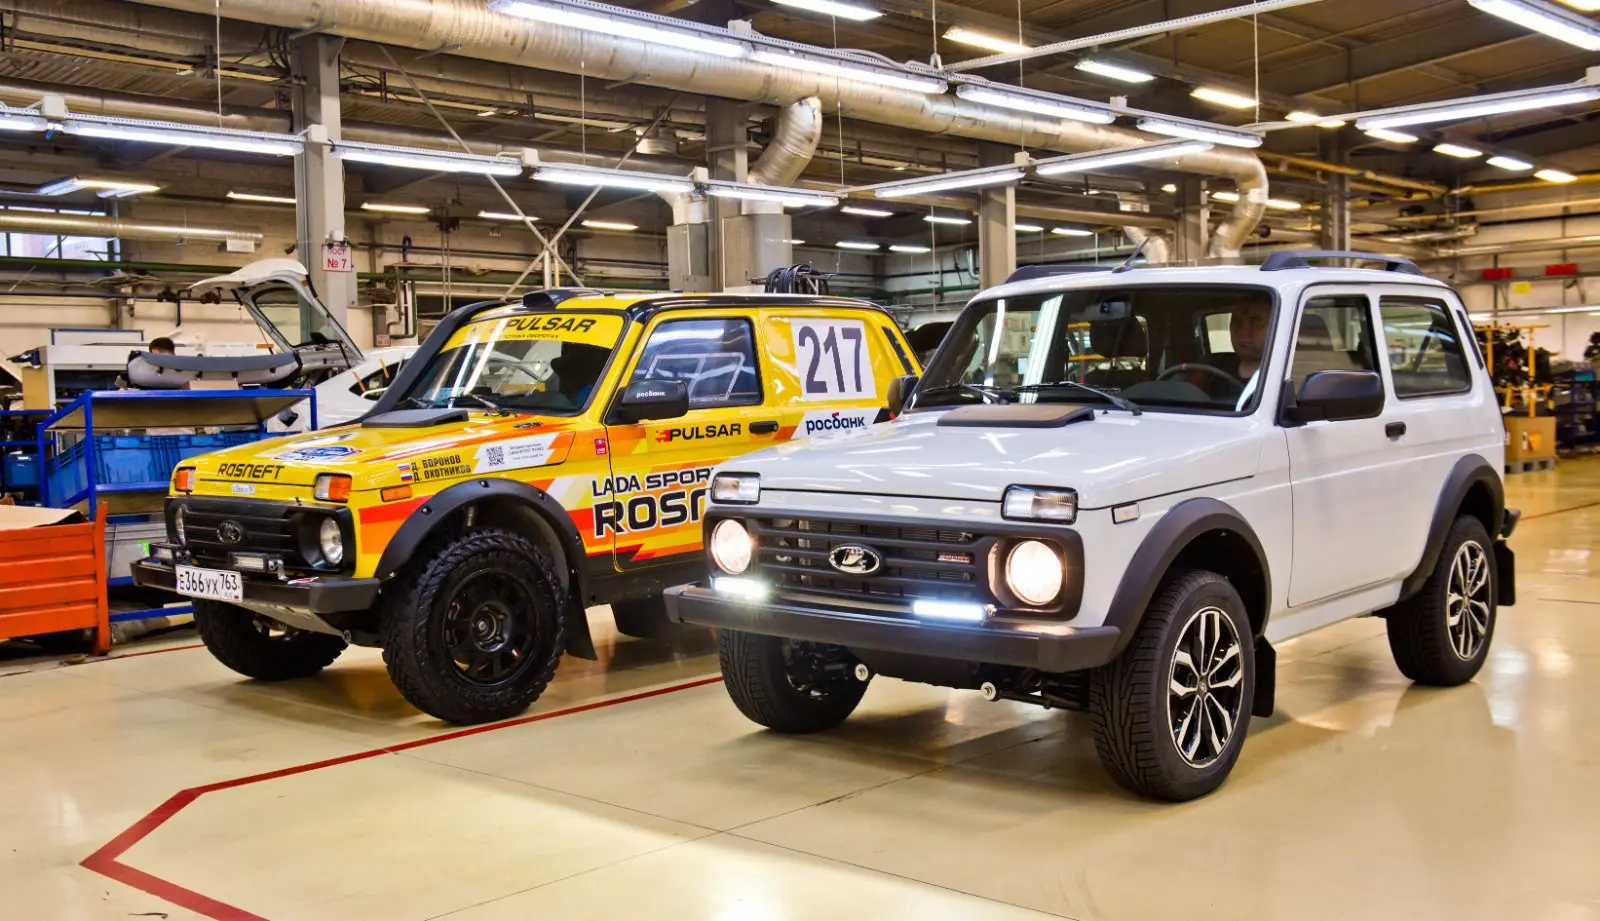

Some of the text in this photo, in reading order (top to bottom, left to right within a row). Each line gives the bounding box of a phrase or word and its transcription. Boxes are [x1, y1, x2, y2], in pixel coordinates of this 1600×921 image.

[328, 258, 347, 268] № 7
[505, 317, 597, 333] PULSAR
[799, 326, 862, 393] 217
[806, 412, 865, 435] росбанк
[669, 424, 741, 442] PULSAR
[422, 454, 462, 468] ВОРОНОВ
[217, 463, 285, 480] ROSNEFT
[413, 464, 472, 482] Д. ОХОТНИКОВ
[592, 467, 714, 497] LADA SPOR
[219, 573, 238, 591] 763
